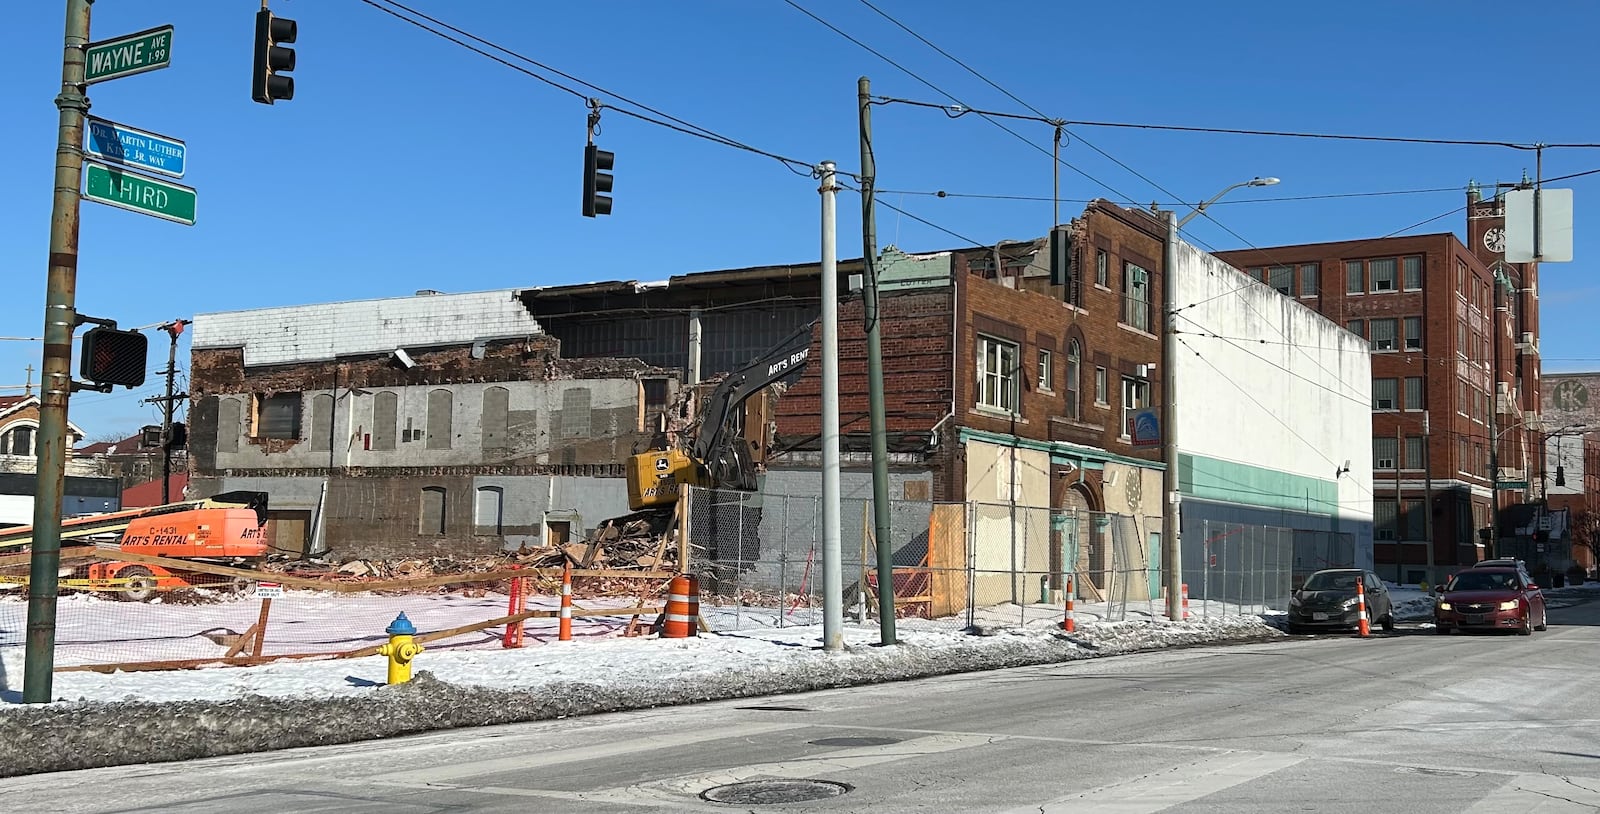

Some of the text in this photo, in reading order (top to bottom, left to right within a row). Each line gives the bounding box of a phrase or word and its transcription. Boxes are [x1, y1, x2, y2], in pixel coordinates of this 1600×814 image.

[92, 35, 166, 75] WAYNE AVE
[148, 49, 165, 63] 1-99
[106, 143, 130, 158] KING
[149, 155, 166, 167] WAY
[112, 131, 145, 148] MARTIN
[148, 140, 182, 158] LUTHER
[108, 178, 168, 209] THIRD
[767, 359, 788, 377] ART'S
[122, 535, 189, 546] ART'S RENTAL
[149, 526, 177, 535] C-1431
